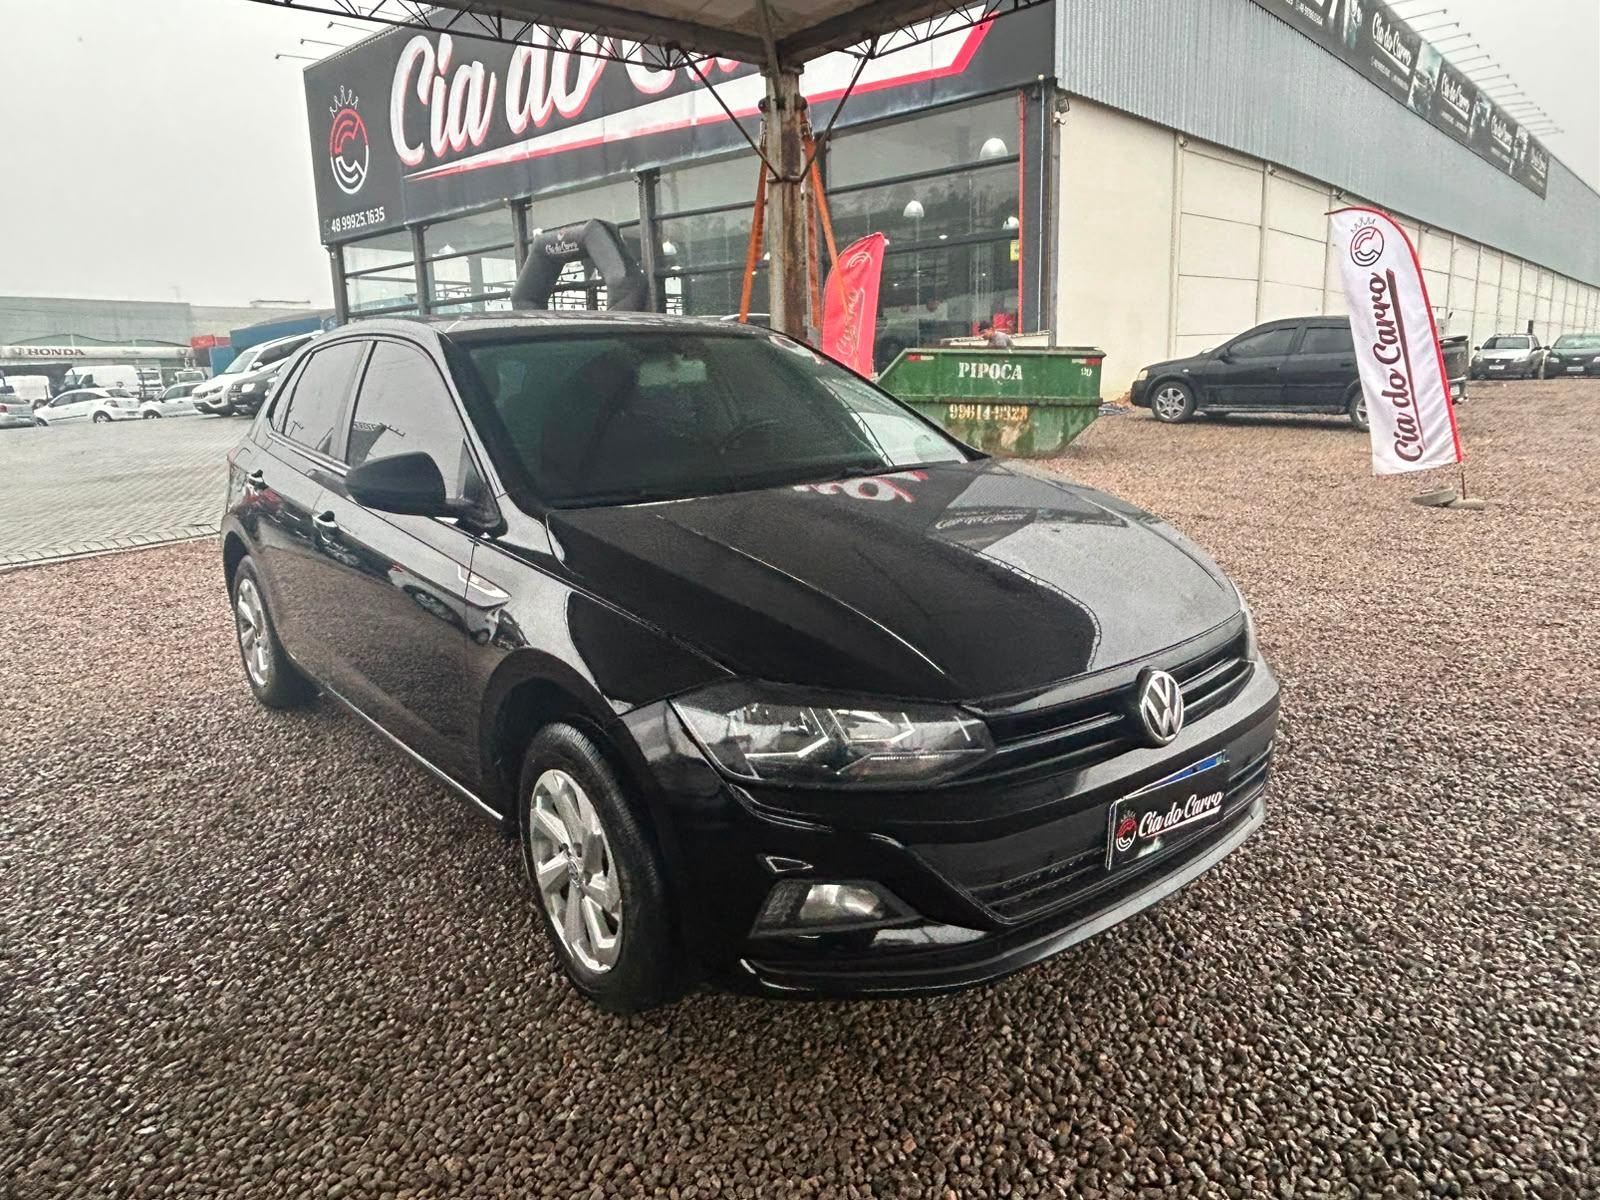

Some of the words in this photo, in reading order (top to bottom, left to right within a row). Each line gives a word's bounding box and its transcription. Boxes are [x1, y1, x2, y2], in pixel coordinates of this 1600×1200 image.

[390, 33, 497, 166] Cia
[505, 22, 614, 134] do
[331, 218, 341, 232] 48
[1369, 271, 1401, 365] Carro
[27, 348, 86, 356] HONDA
[958, 362, 1023, 380] PIPOCA
[1382, 368, 1410, 408] do
[1394, 411, 1424, 462] Cia
[1138, 810, 1164, 838] Cia
[1163, 802, 1184, 824] do
[1184, 791, 1224, 817] Carro
